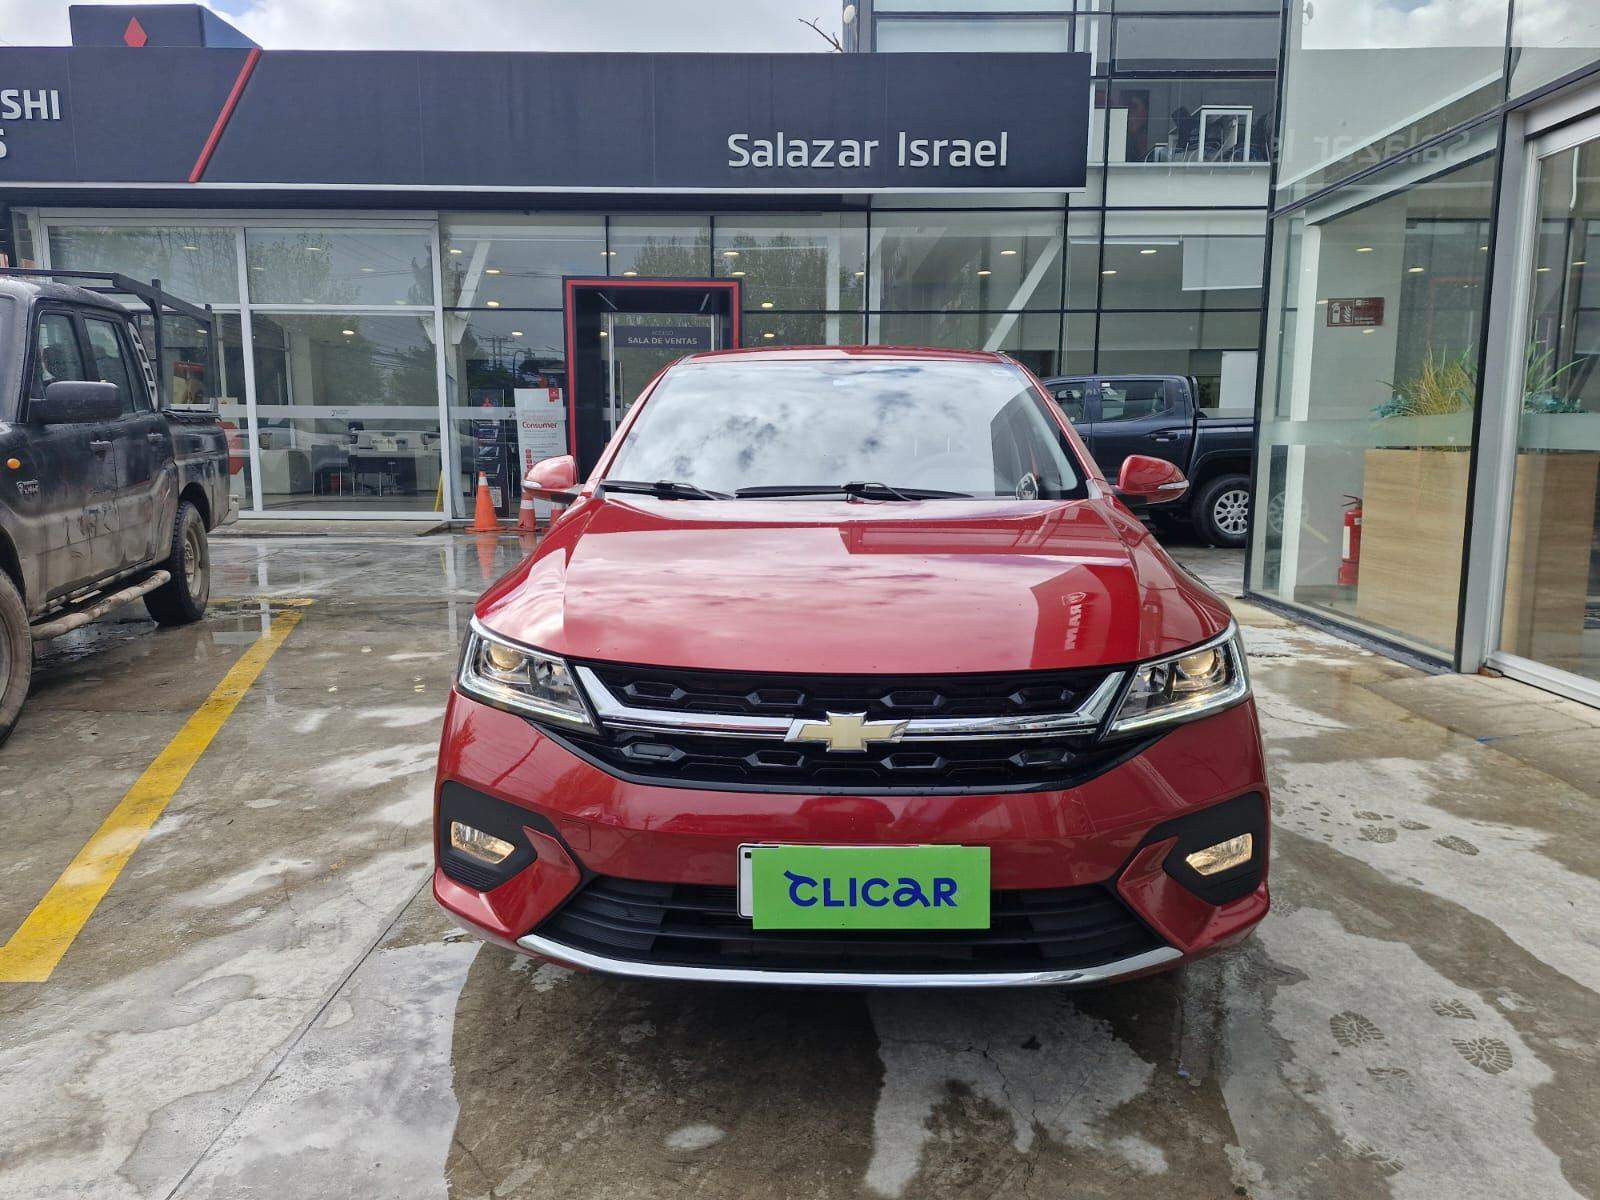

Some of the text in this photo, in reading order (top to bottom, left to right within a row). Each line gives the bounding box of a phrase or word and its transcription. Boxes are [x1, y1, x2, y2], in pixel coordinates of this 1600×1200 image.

[0, 89, 60, 120] SHI
[727, 131, 1008, 168] Salazar Israel
[627, 336, 698, 345] SALA DE VENTAS
[522, 421, 558, 429] Consumer
